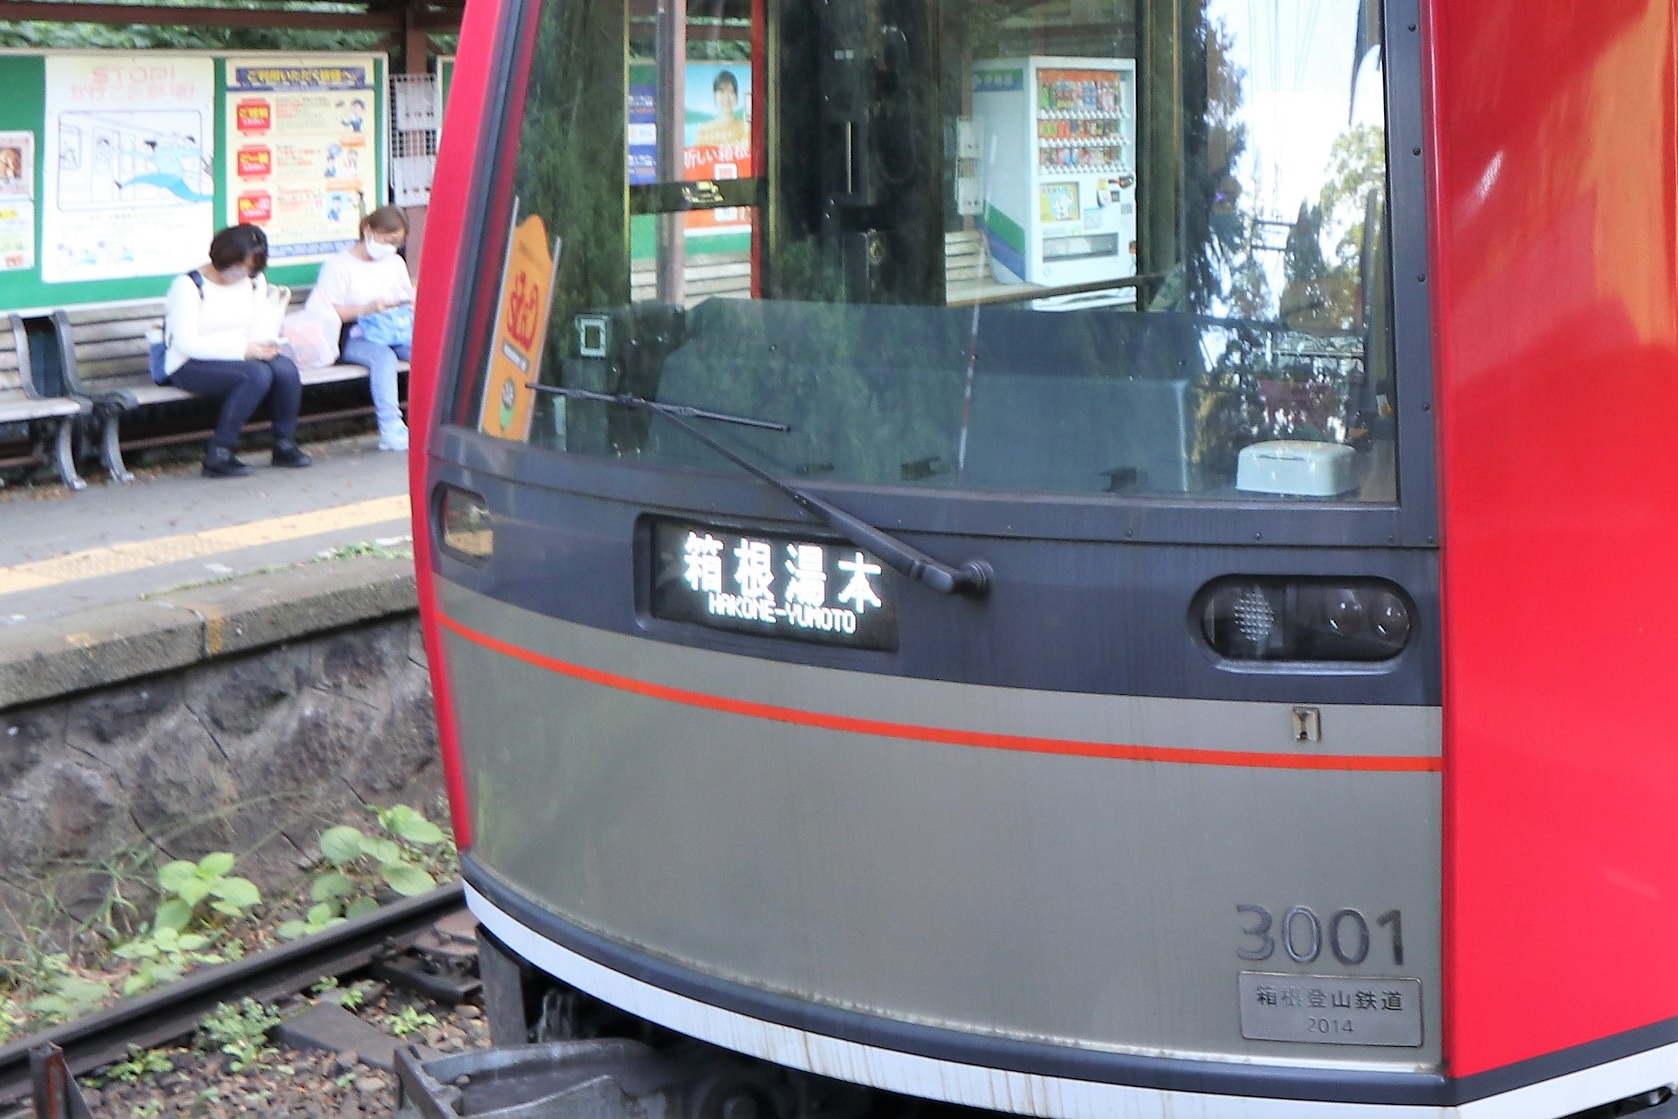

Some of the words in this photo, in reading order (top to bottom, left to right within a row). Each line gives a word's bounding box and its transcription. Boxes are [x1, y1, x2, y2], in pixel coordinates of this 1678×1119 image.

[684, 531, 882, 614] 箱根湯本
[708, 591, 857, 634] HAKONE-YUMOTO
[1236, 904, 1404, 966] 3001
[1256, 984, 1403, 1011] 箱根登山鉄道
[1307, 1017, 1354, 1034] 2014
